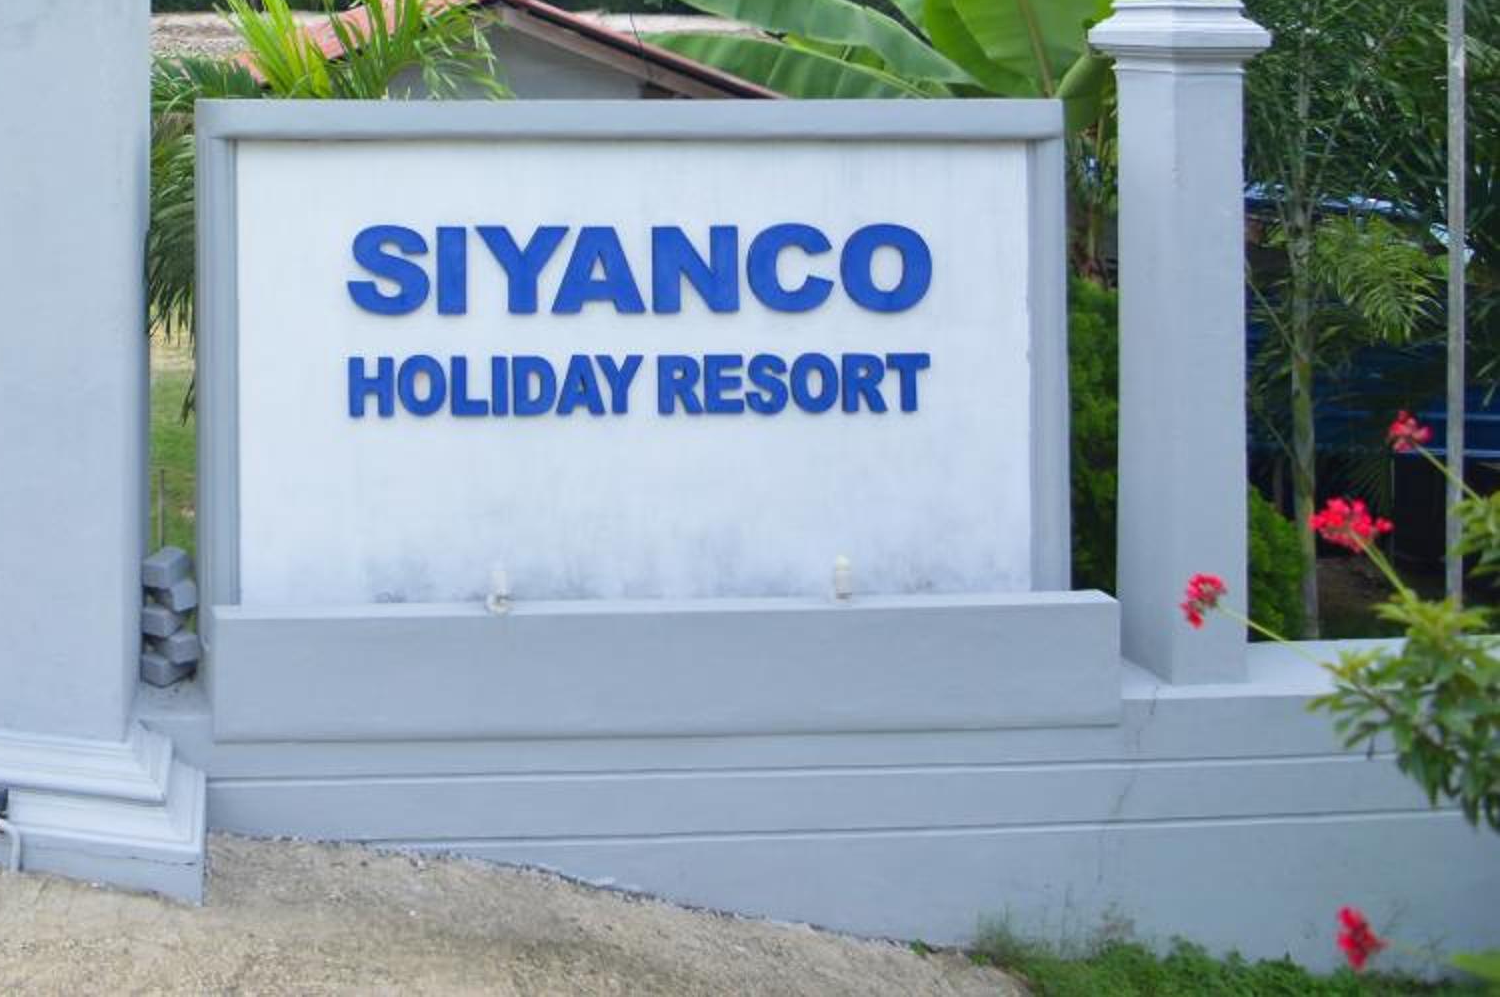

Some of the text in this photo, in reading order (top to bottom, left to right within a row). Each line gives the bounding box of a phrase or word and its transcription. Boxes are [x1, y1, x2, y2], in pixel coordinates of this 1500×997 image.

[347, 223, 933, 316] SIYANCO
[347, 352, 931, 418] HOLIDAY RESORT
